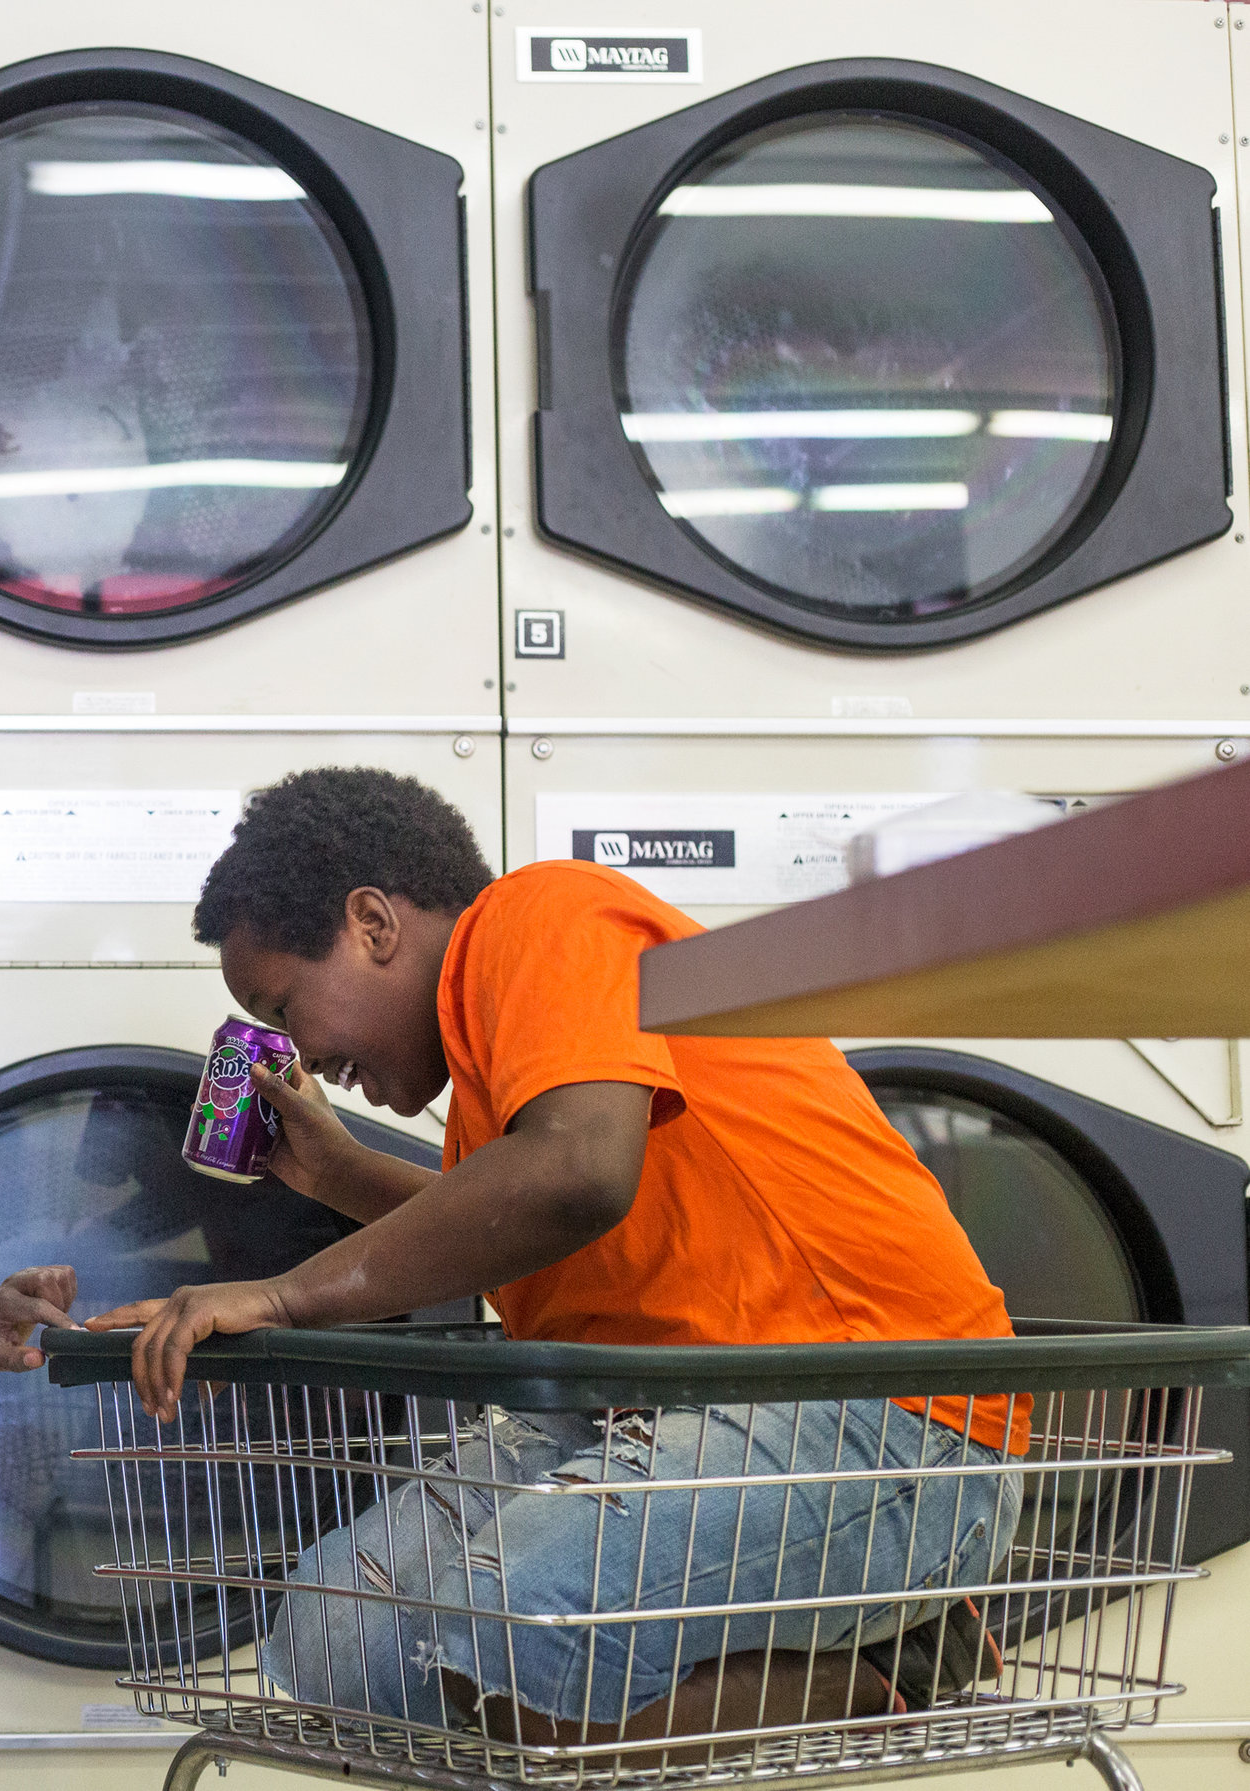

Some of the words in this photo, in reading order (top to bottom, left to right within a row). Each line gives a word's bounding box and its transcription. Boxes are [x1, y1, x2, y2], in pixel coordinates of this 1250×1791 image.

[587, 47, 669, 65] MAYTAG
[530, 623, 547, 644] 5
[632, 840, 714, 859] MAYTAG
[225, 1036, 249, 1050] GRAPE
